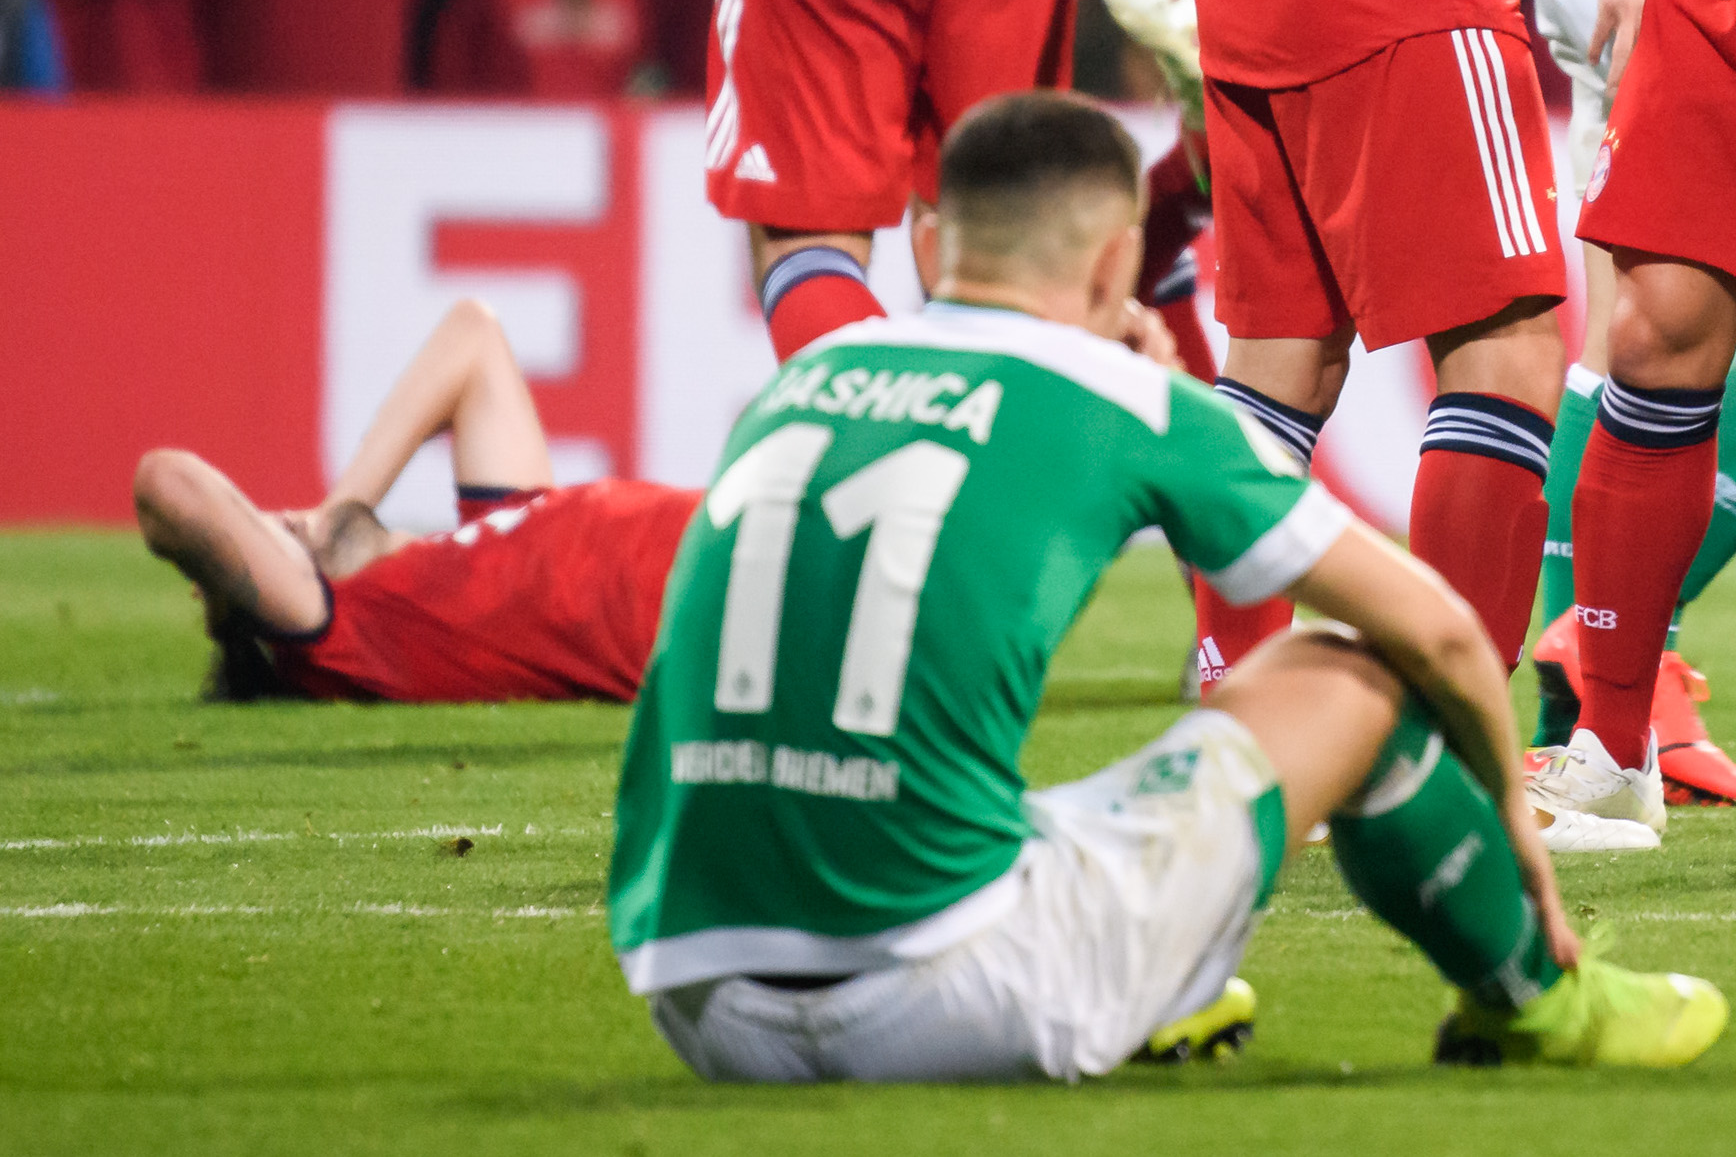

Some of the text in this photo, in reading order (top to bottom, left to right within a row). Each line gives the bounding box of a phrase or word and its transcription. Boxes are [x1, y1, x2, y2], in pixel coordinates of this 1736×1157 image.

[760, 364, 1004, 445] ASHICA
[705, 422, 971, 737] 11
[1574, 603, 1618, 630] FCB
